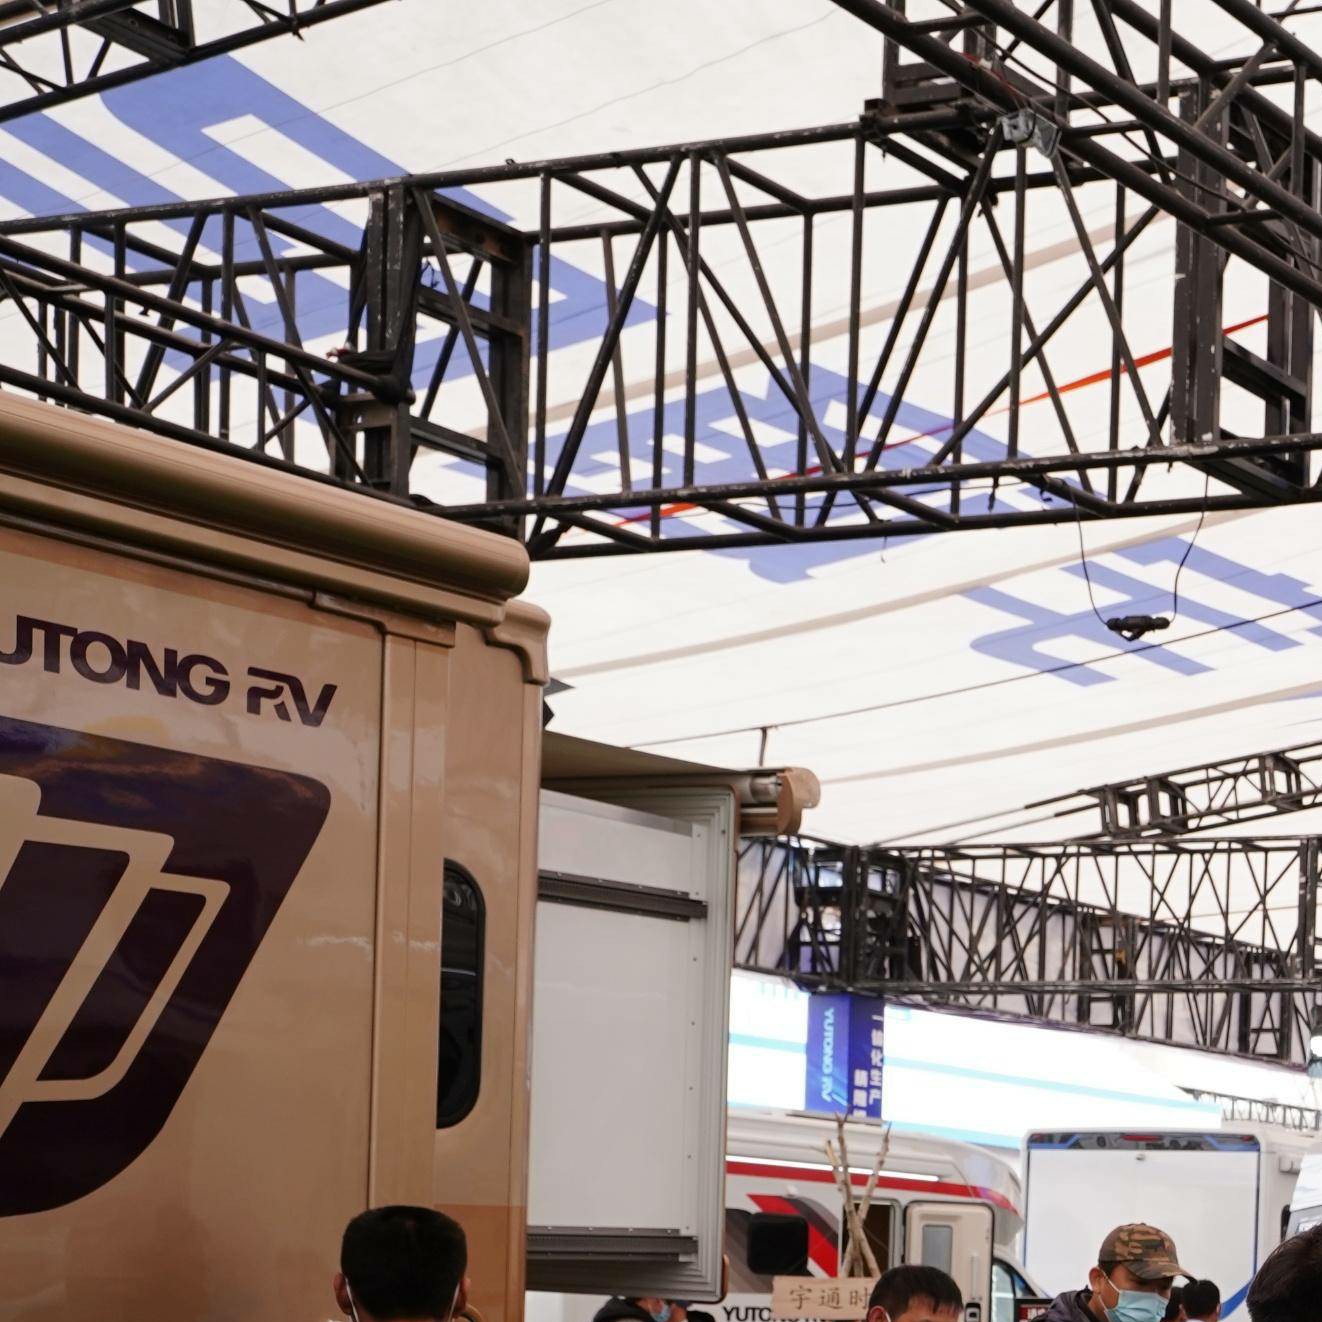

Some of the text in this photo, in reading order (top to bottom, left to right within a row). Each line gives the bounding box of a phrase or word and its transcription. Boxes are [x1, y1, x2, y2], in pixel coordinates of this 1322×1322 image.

[247, 666, 338, 727] RV
[821, 1007, 835, 1102] YUTONG RV
[723, 1306, 799, 1322] YUTO
